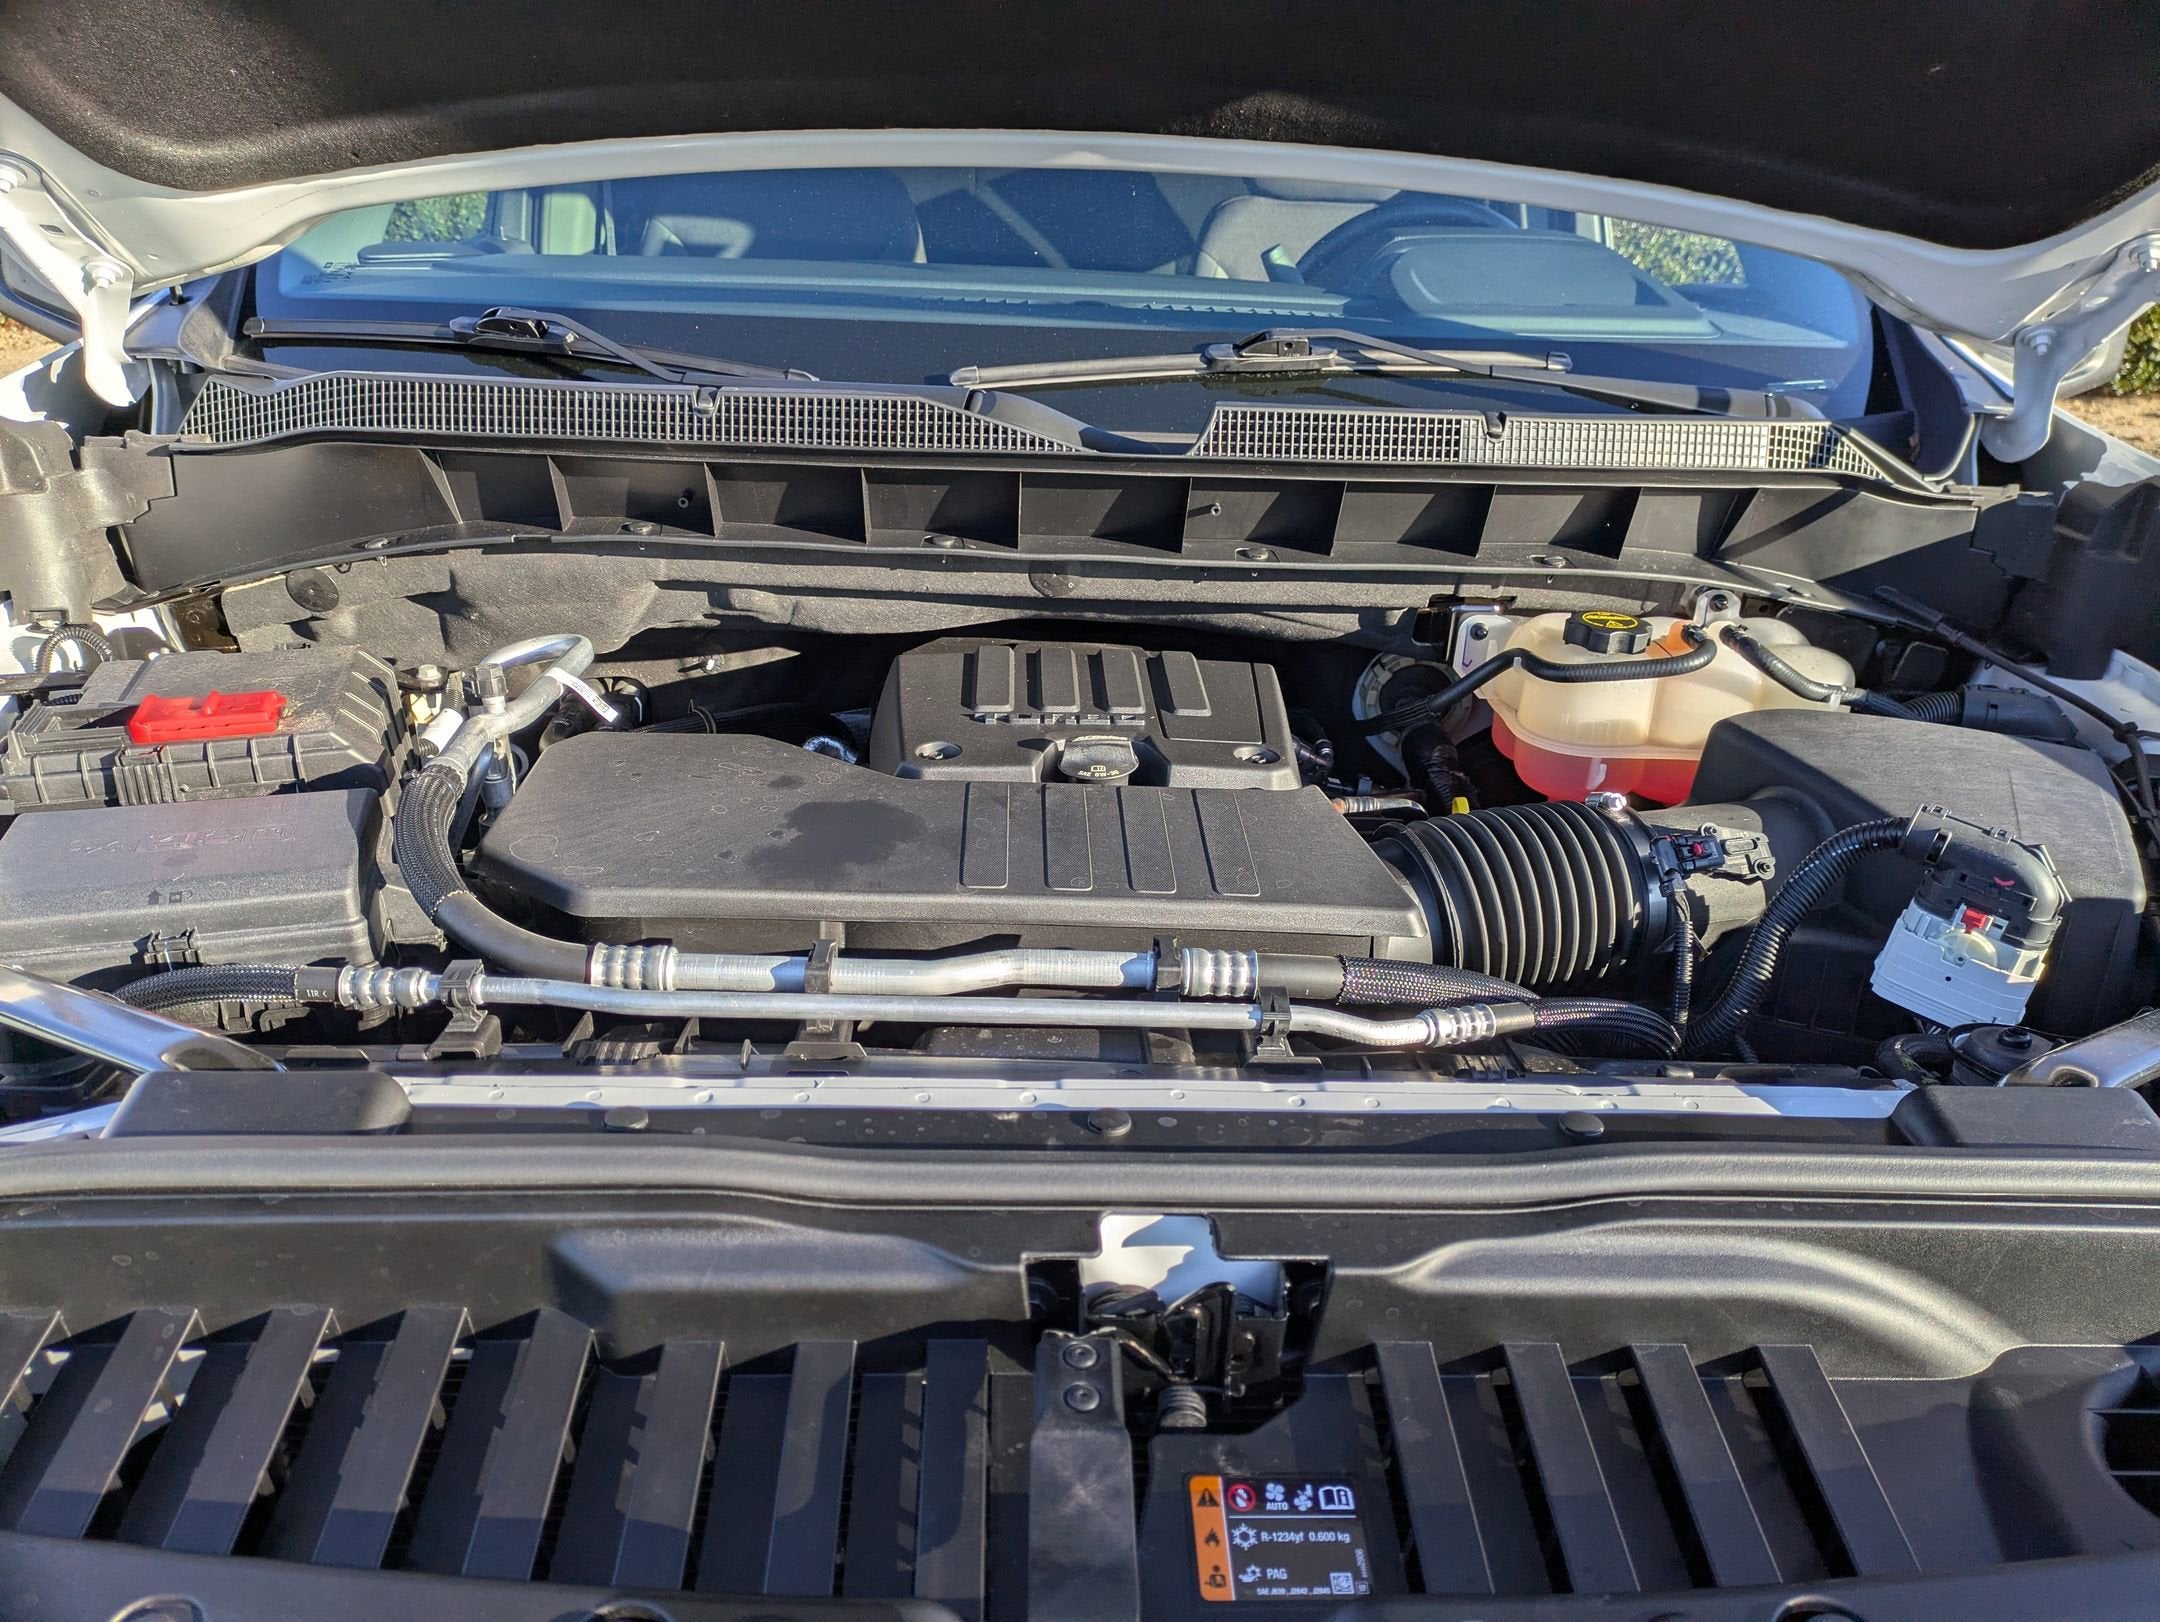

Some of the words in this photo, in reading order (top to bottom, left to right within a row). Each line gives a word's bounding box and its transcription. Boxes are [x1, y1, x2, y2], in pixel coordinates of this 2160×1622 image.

[1266, 1501, 1289, 1511] AUTO
[1260, 1531, 1304, 1544] R-1234yf
[1308, 1531, 1336, 1543] 0.600
[1337, 1531, 1351, 1544] kg
[1266, 1568, 1288, 1580] PAG
